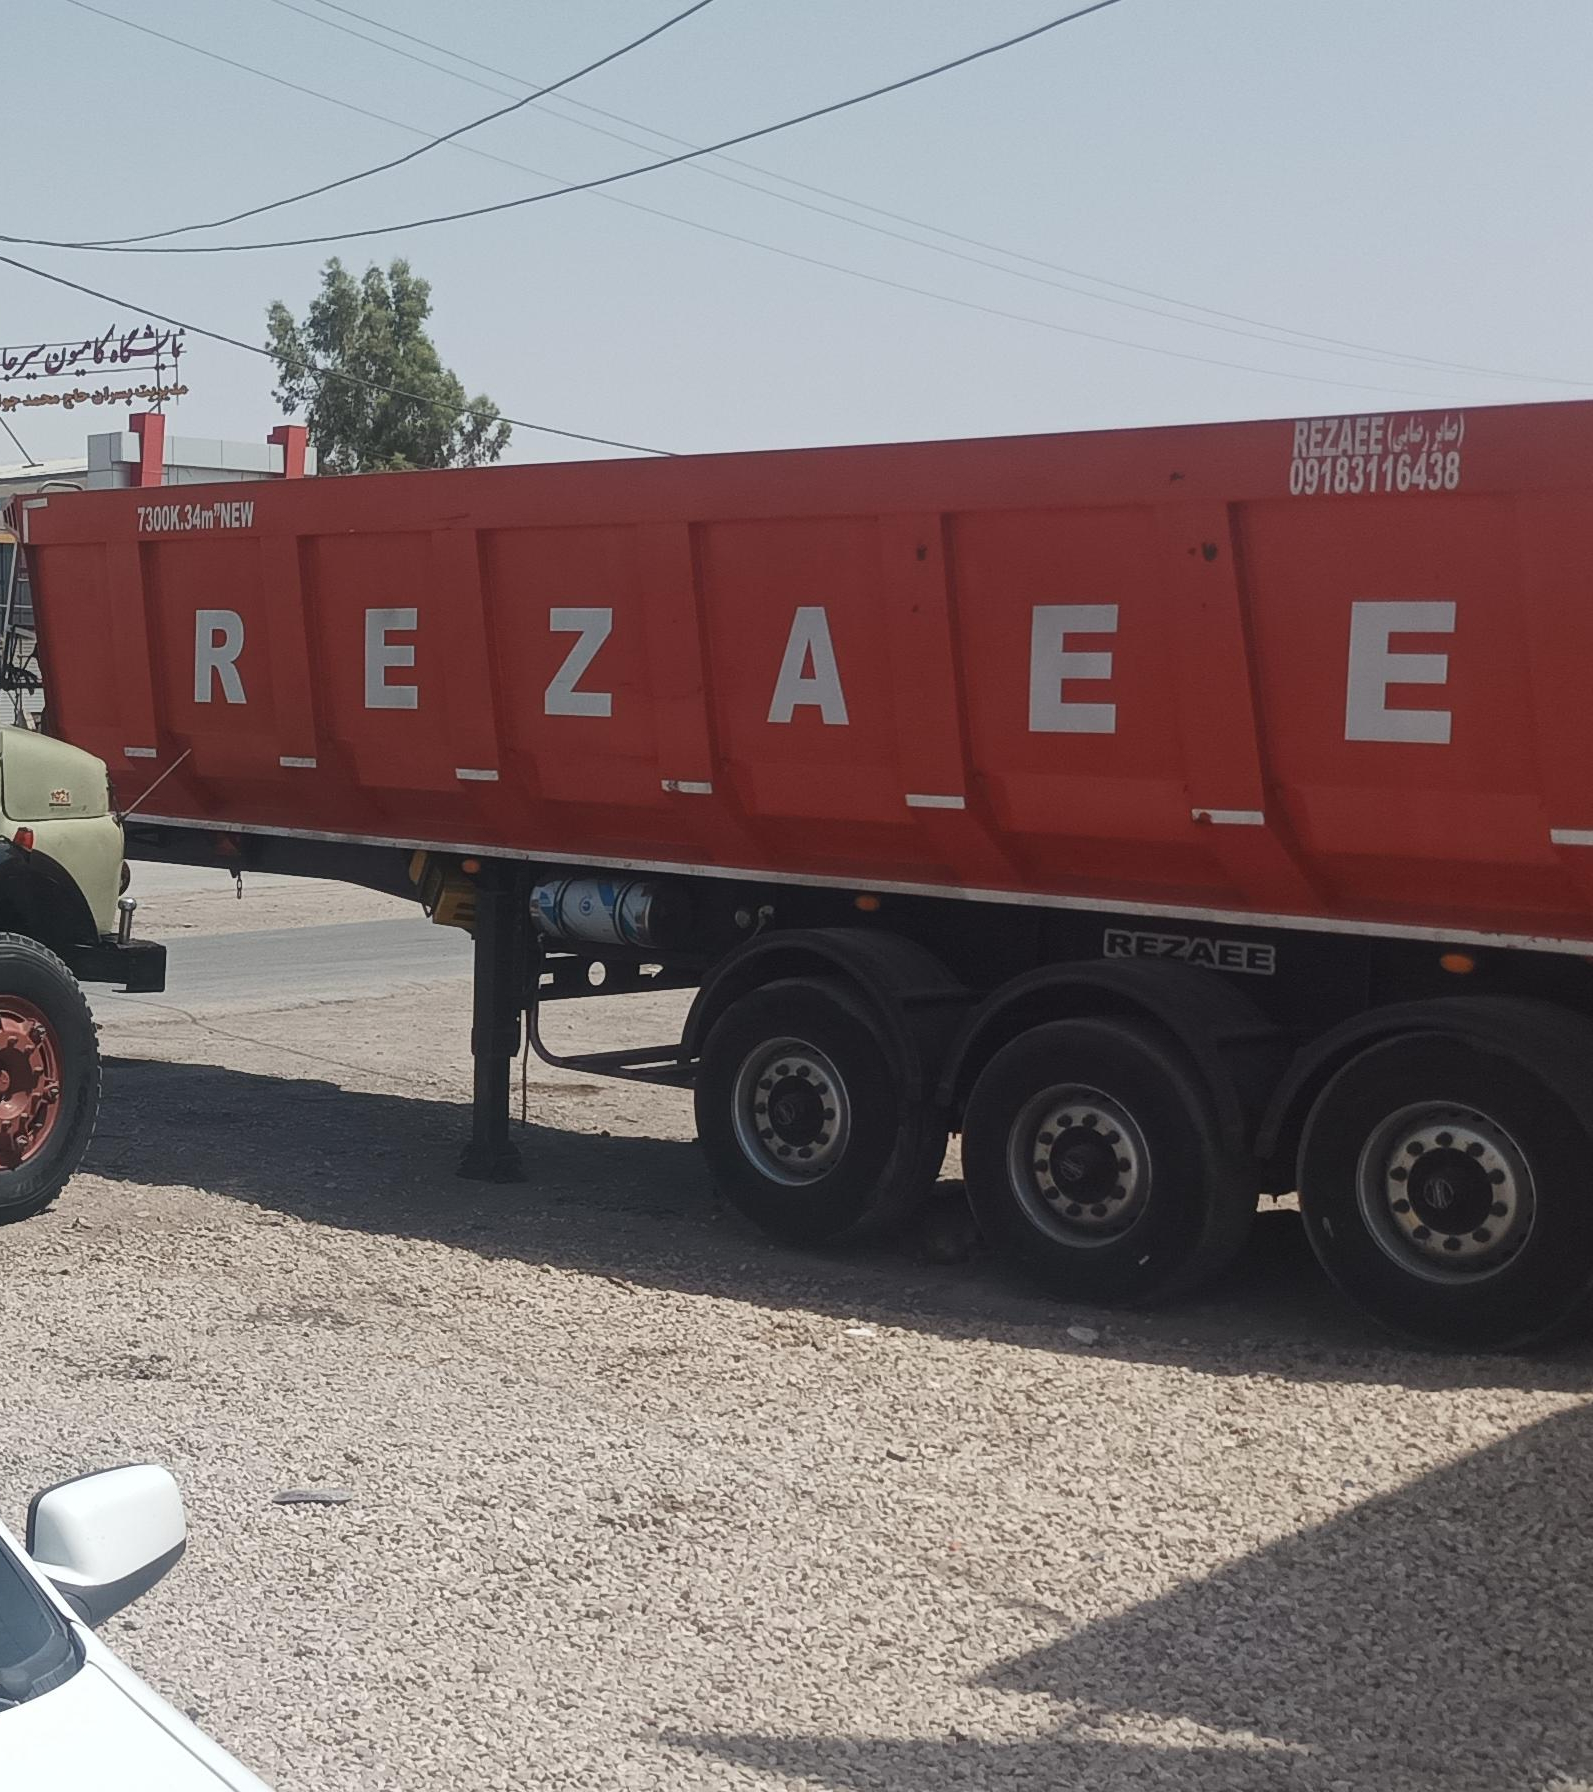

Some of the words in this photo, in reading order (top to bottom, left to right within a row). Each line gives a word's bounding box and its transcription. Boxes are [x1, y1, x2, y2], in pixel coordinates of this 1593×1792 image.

[44, 323, 116, 378] کامیون
[110, 323, 186, 371] نمایشگاه
[22, 393, 61, 408] محمد
[63, 388, 90, 410] حاج
[91, 386, 133, 406] پسران
[135, 383, 188, 404] مدیریت
[1292, 416, 1385, 458] REZAEE
[1289, 450, 1461, 496] 09183116438
[1103, 928, 1276, 975] REZAEE
